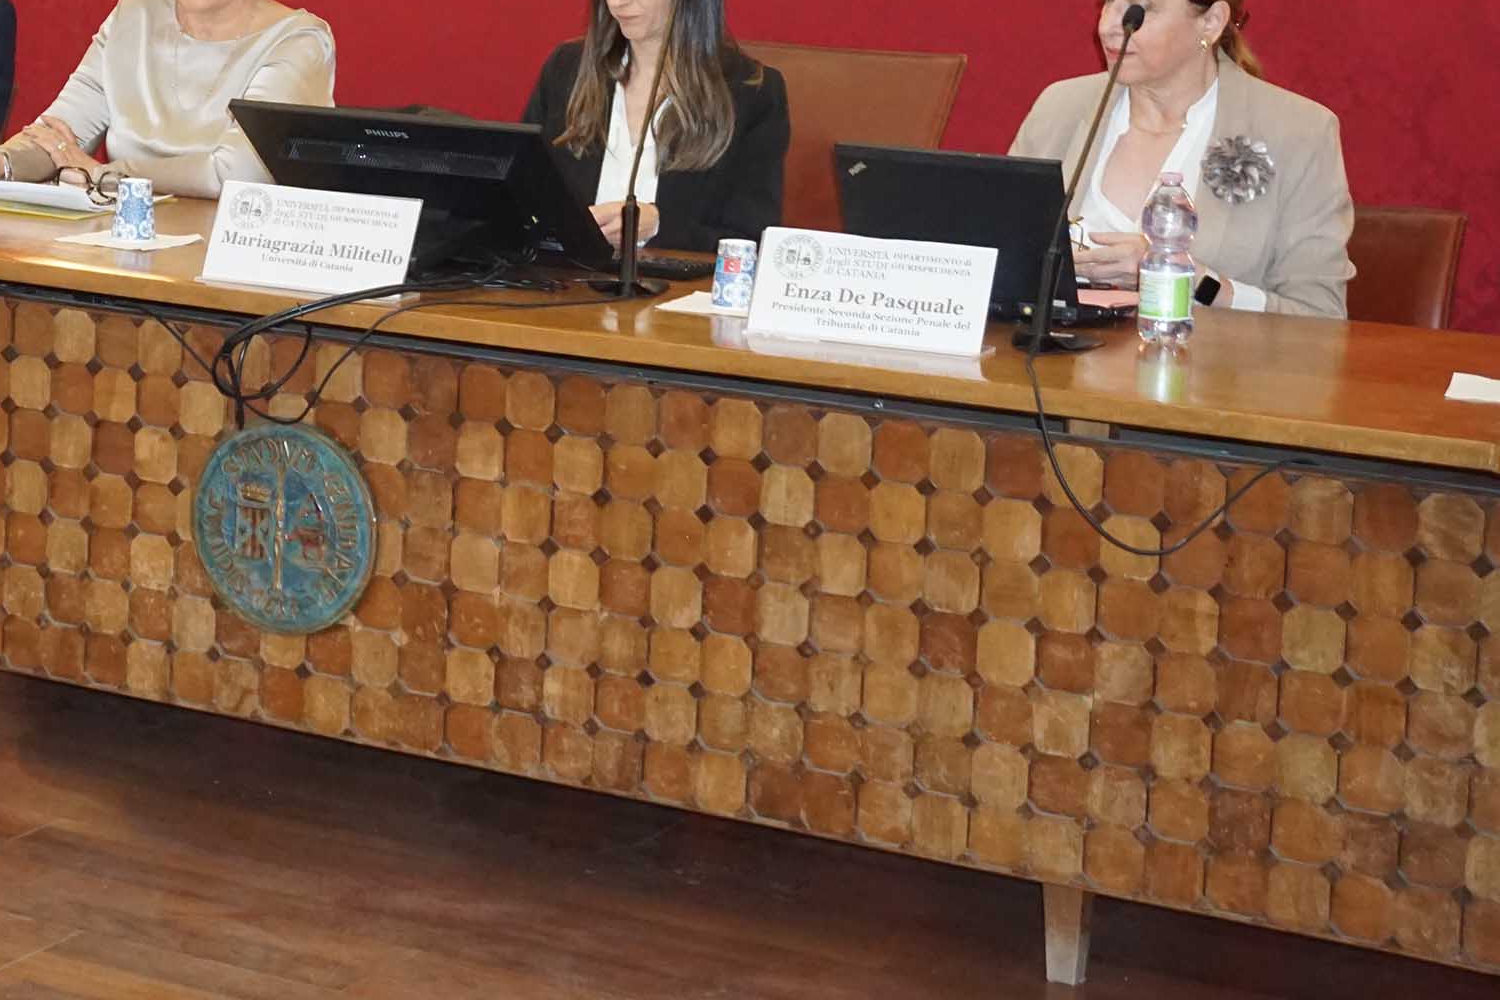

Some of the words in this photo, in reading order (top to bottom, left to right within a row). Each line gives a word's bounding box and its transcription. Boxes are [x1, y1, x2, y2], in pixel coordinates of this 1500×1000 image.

[364, 128, 410, 139] PHILIPS
[221, 230, 325, 256] Mariagrazia
[329, 243, 403, 266] Militello
[261, 253, 307, 267] Università
[308, 258, 318, 267] di
[319, 260, 354, 273] Catania
[853, 259, 890, 270] STUDI
[836, 266, 886, 280] CATANIA
[784, 282, 832, 302] Enza
[838, 287, 865, 305] De
[871, 291, 964, 316] Pasquale
[772, 301, 825, 315] Presidente
[828, 306, 871, 320] Seconda
[874, 312, 914, 324] Sezione
[916, 317, 956, 329] Penale
[957, 320, 971, 330] del
[816, 318, 866, 331] Tribunale
[868, 324, 879, 333] di
[881, 325, 920, 337] Catania
